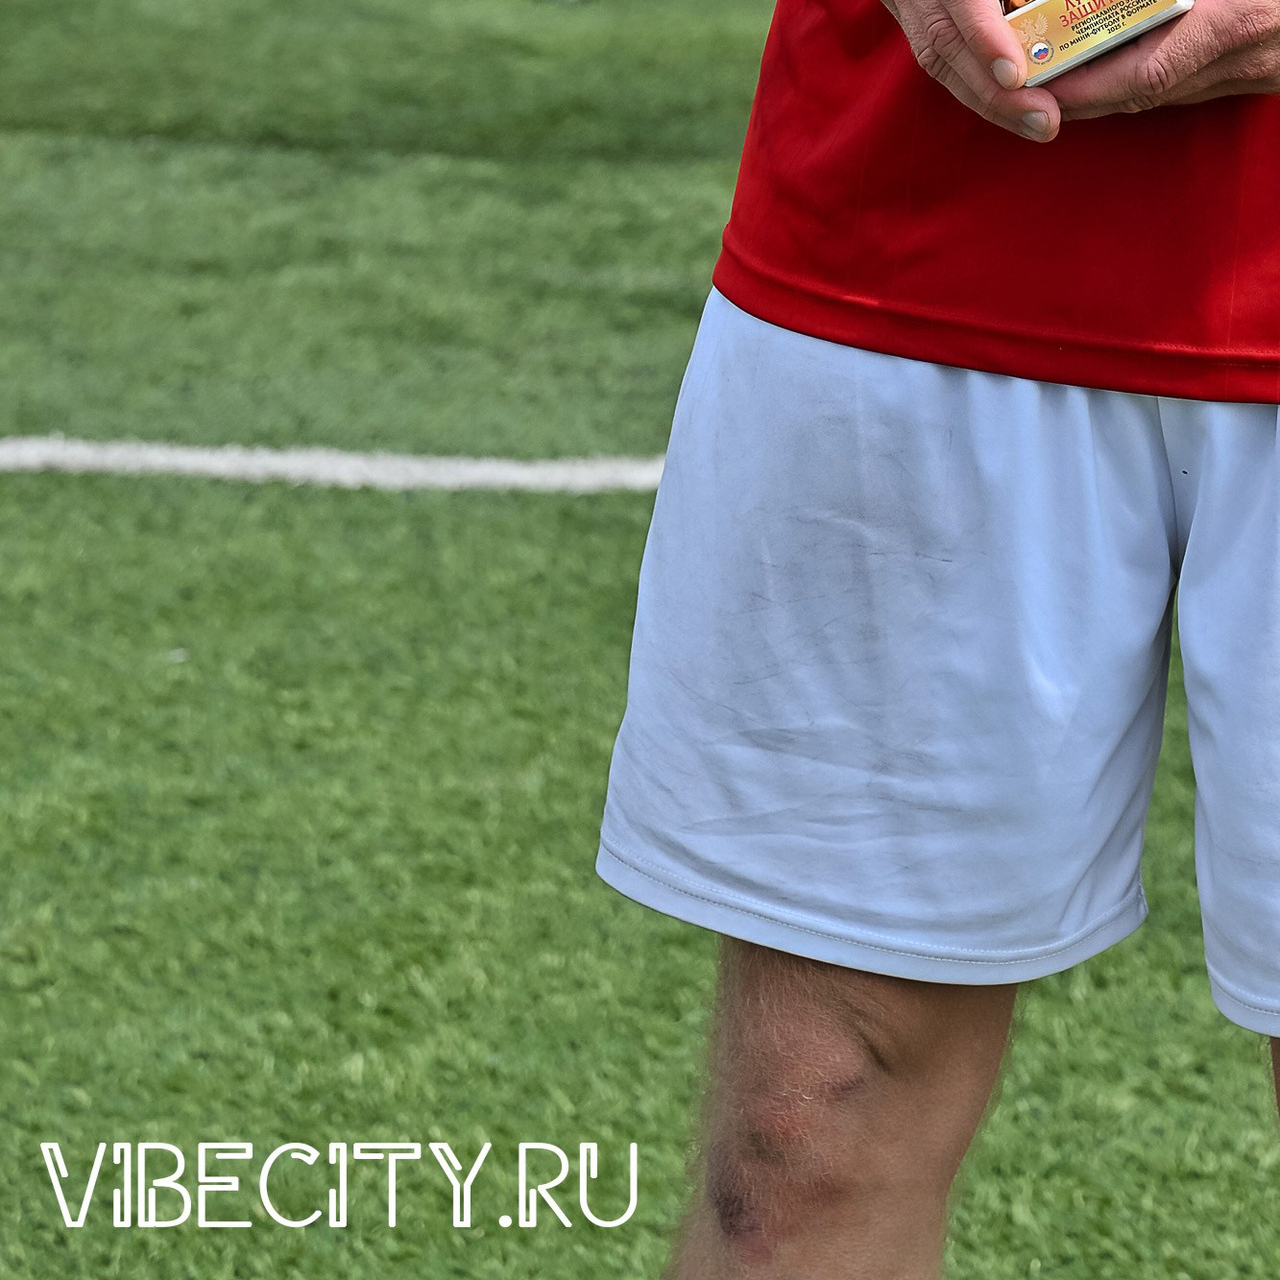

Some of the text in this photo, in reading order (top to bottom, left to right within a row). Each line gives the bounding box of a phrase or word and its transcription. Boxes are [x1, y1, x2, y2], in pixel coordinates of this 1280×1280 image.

[1071, 0, 1125, 32] РЕГИОНАЛЬНОГО
[1075, 10, 1120, 36] ЧЕМПИОНАТА
[1107, 23, 1124, 35] 2025
[1059, 43, 1070, 52] ПО
